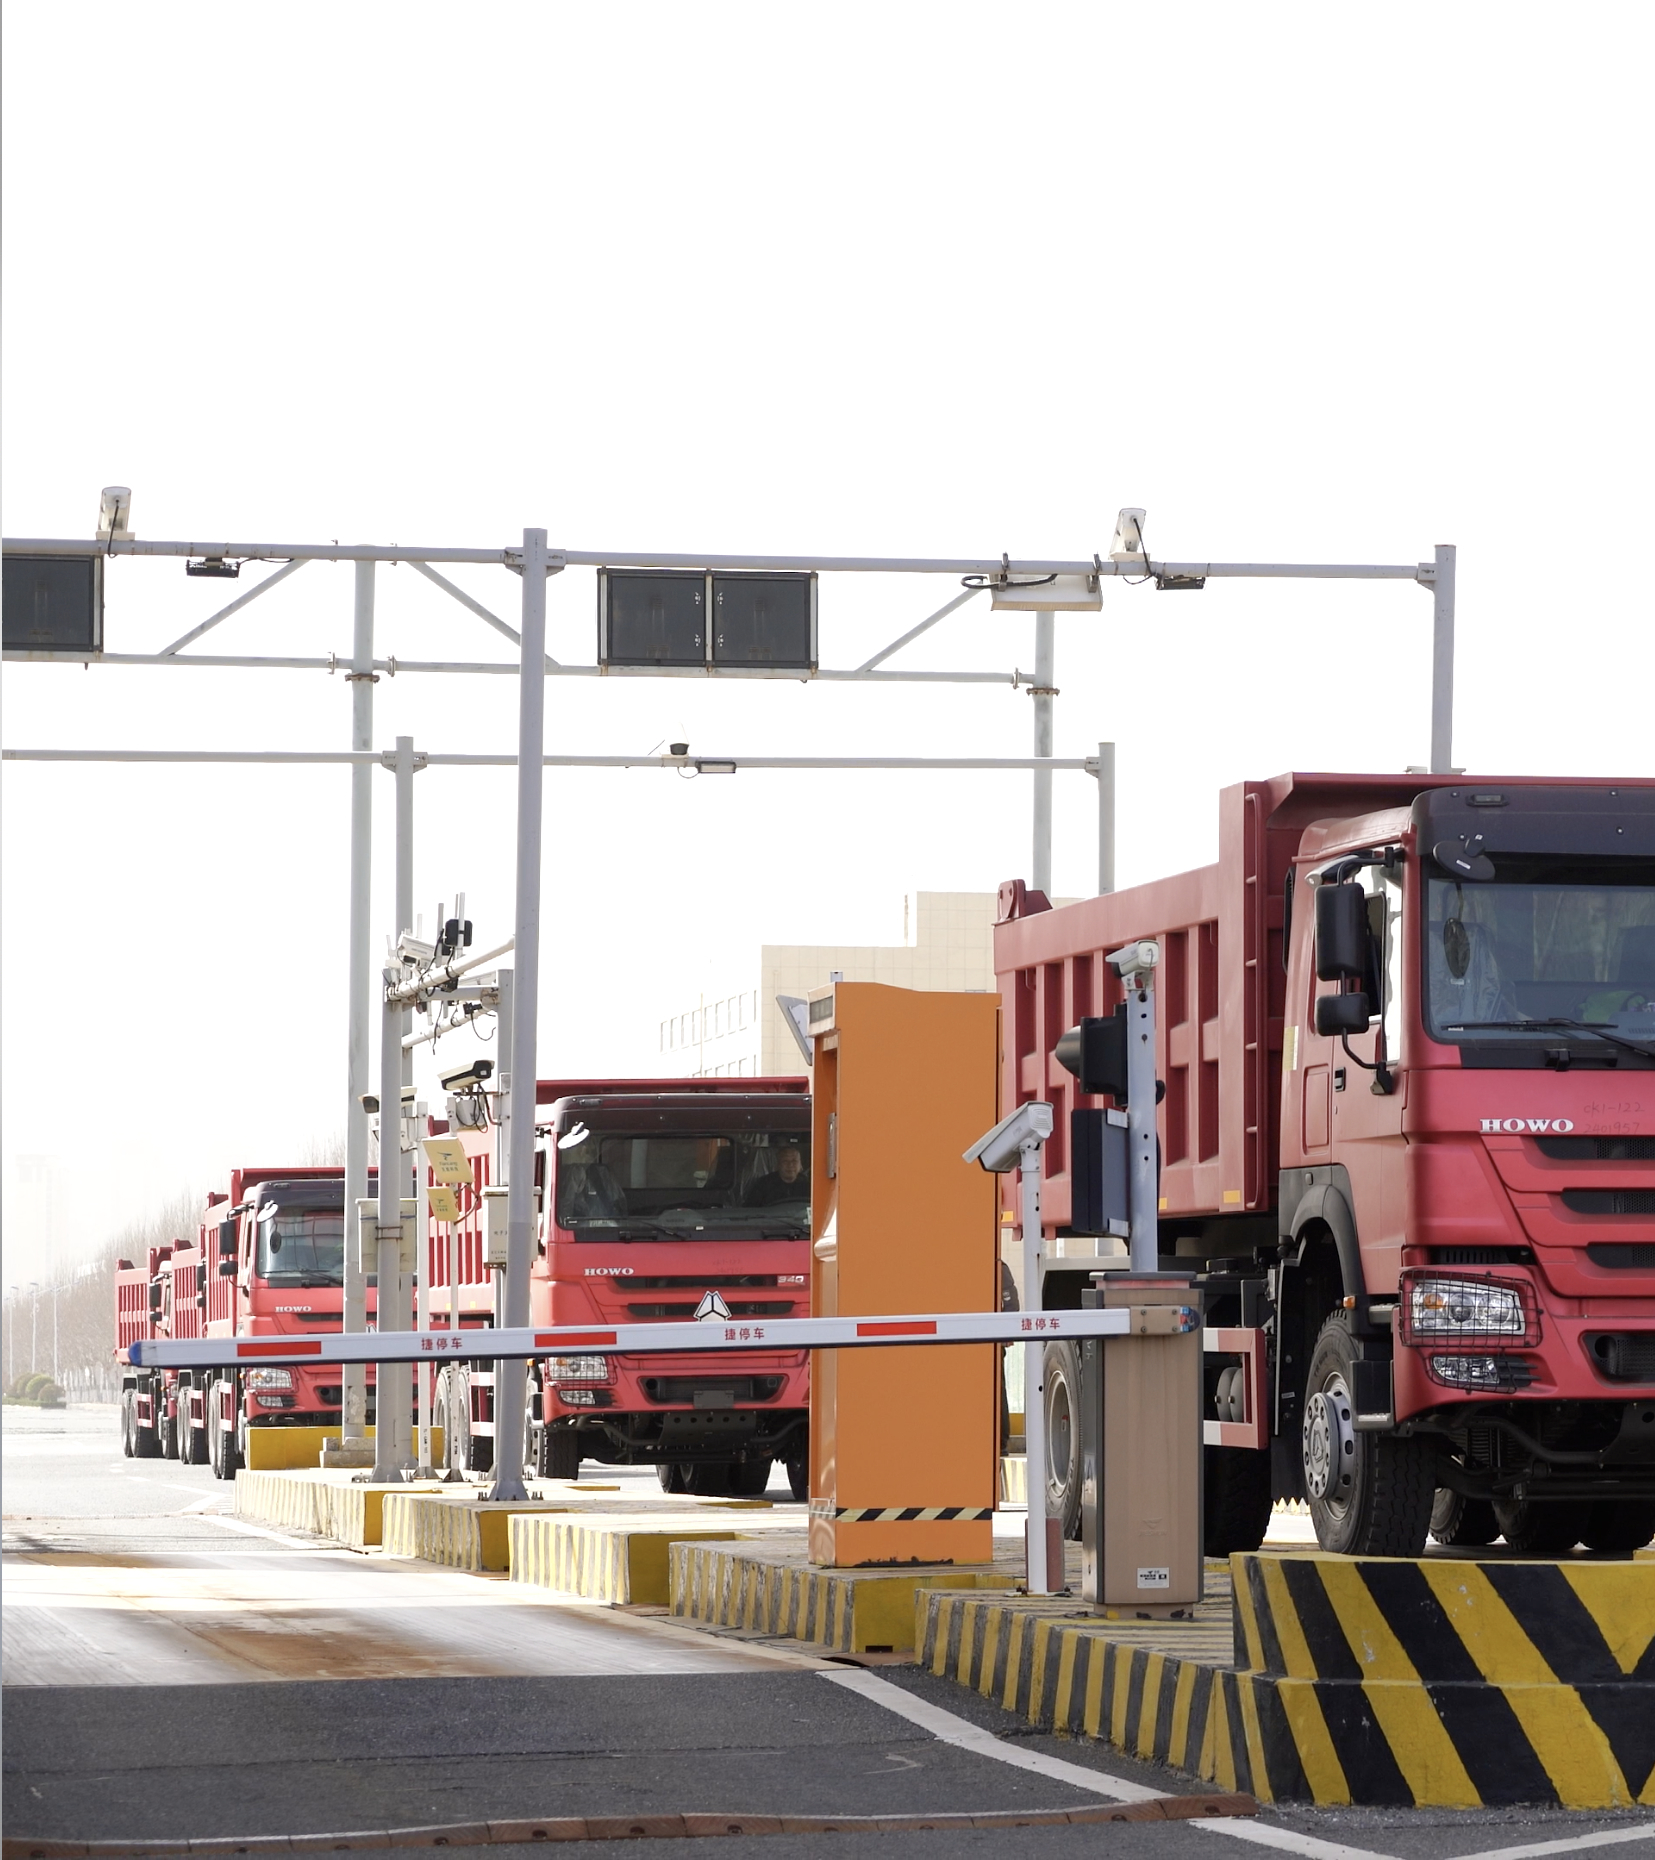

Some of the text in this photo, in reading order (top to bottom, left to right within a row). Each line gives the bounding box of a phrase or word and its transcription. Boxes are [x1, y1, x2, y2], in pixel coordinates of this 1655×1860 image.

[1480, 1118, 1574, 1133] HOWO
[584, 1267, 634, 1276] HOWO
[1021, 1317, 1060, 1331] 捷停车
[724, 1327, 765, 1341] 捷停车
[421, 1337, 463, 1351] 捷停车
